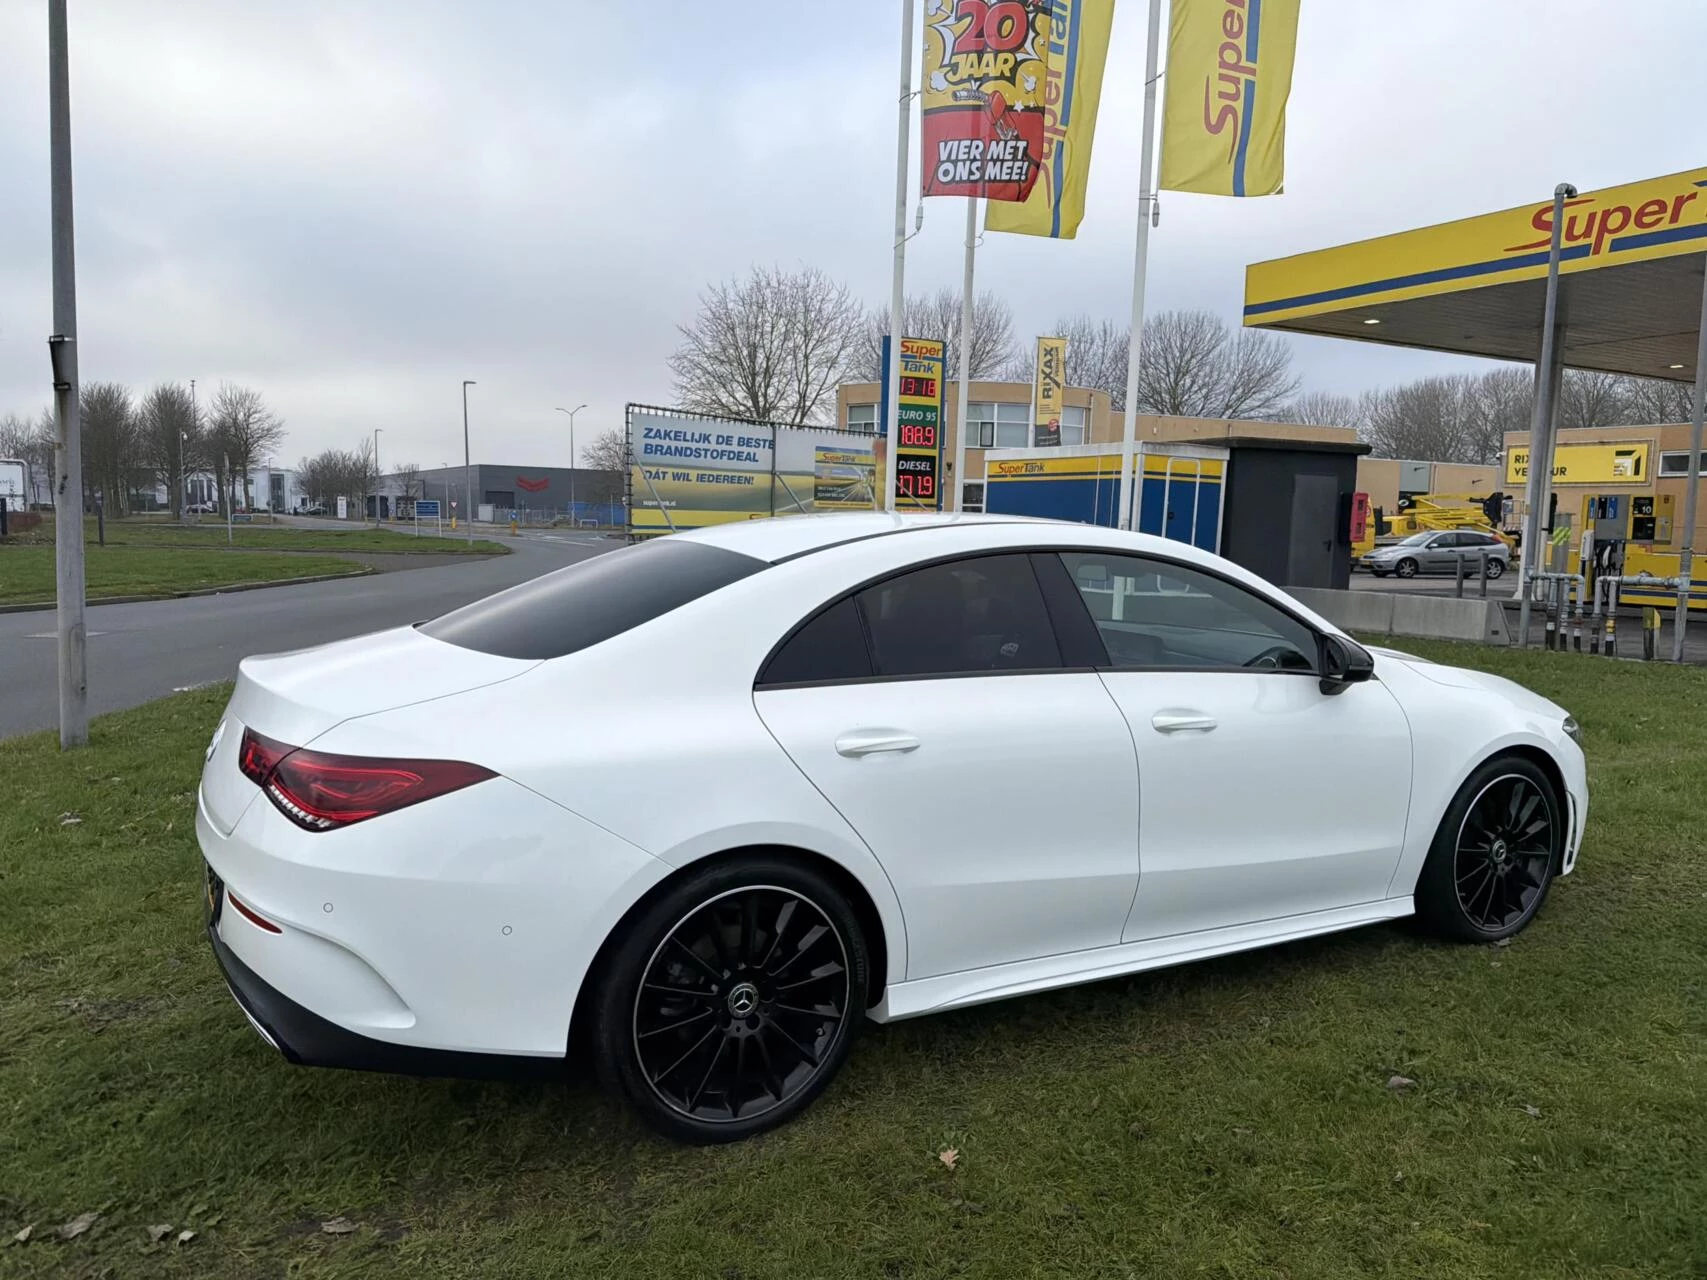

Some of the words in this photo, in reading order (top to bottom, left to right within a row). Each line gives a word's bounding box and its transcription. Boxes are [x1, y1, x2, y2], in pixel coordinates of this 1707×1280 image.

[953, 0, 1028, 52] 20
[944, 53, 1016, 83] JAAR
[939, 140, 984, 160] VIER
[986, 140, 1028, 160] MET
[937, 161, 982, 182] ONS
[984, 161, 1029, 180] MEE!
[900, 340, 942, 360] Super
[901, 360, 935, 374] Tank
[897, 410, 923, 421] EURO
[925, 412, 937, 421] 95
[643, 427, 712, 445] ZAKELIJK
[716, 434, 734, 446] DE
[737, 436, 775, 450] BESTE
[644, 443, 759, 463] BRANDSTOFDEAL
[898, 460, 932, 471] DIESEL
[671, 472, 692, 483] WIL
[696, 473, 755, 485] IEDEREEN!
